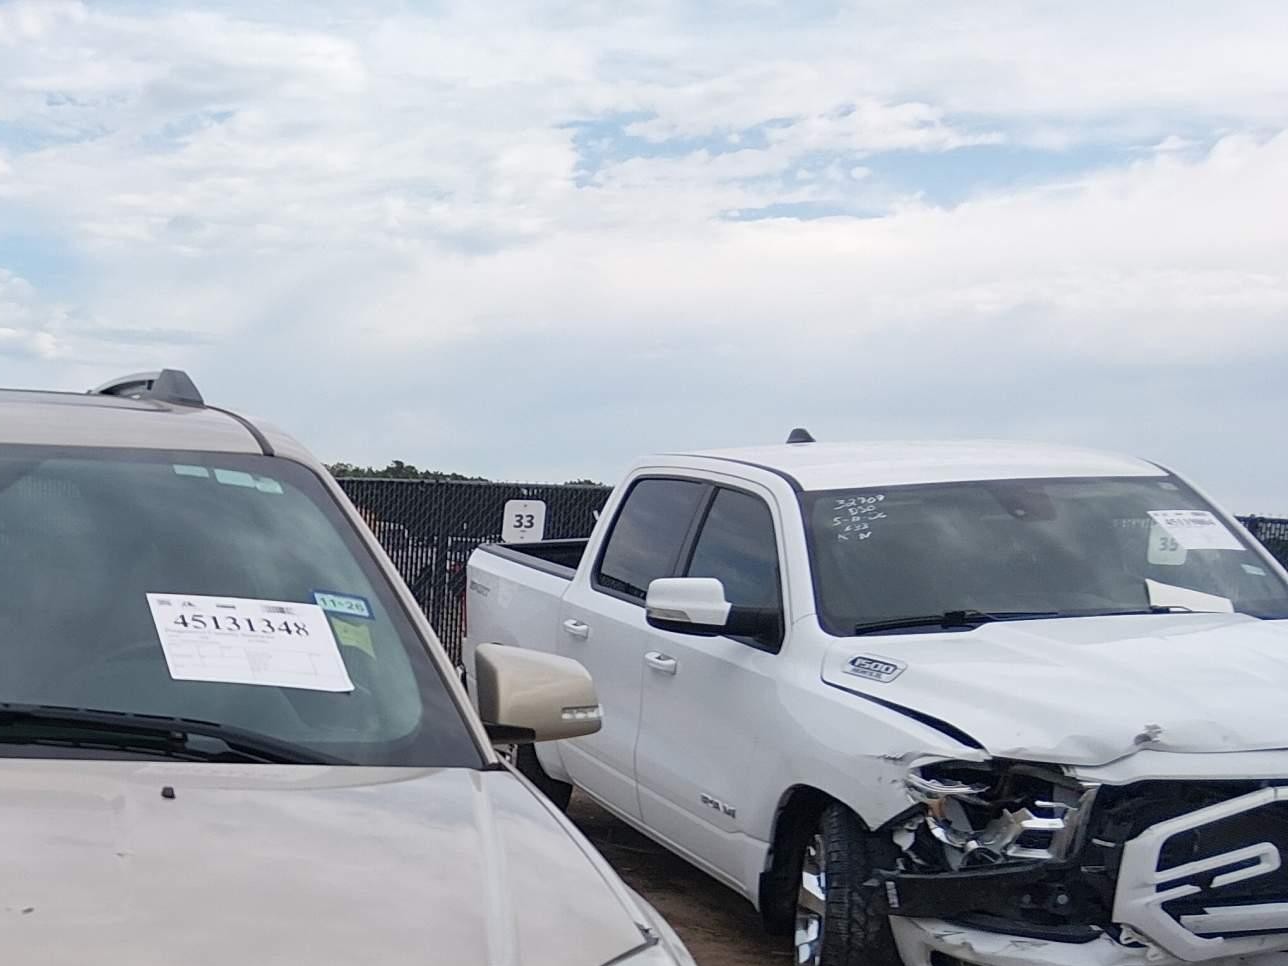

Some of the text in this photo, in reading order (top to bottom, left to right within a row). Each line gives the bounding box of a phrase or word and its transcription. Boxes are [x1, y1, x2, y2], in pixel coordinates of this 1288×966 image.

[513, 514, 535, 529] 33
[173, 613, 310, 637] 45131348
[854, 658, 895, 674] 1500
